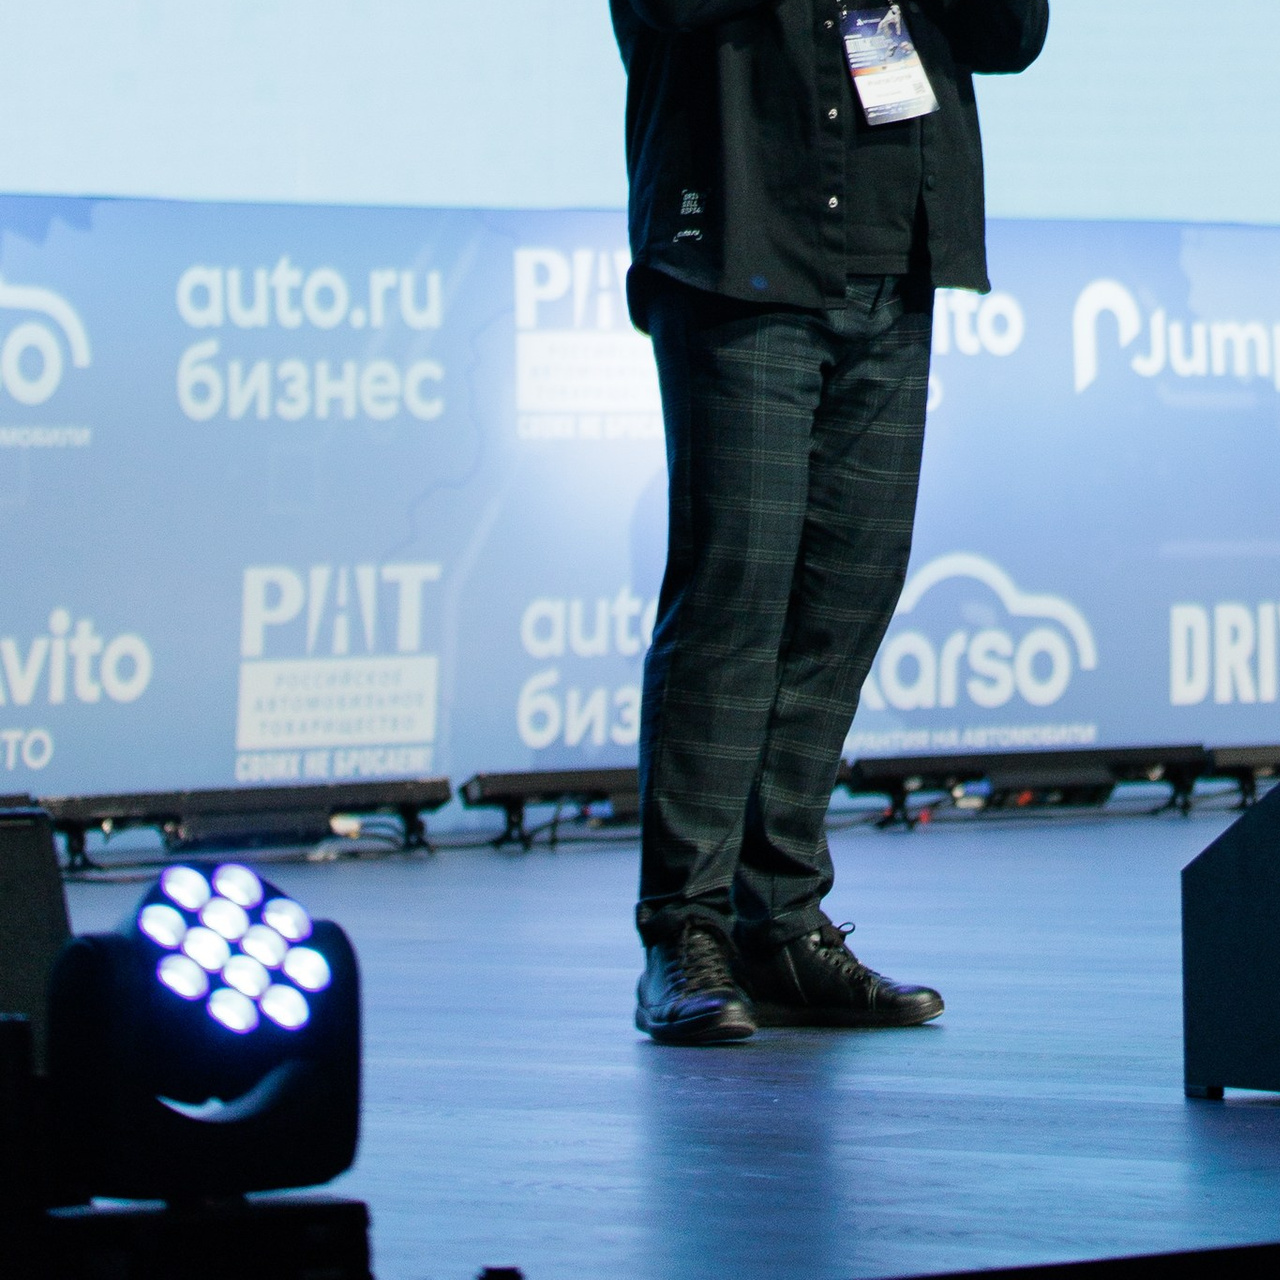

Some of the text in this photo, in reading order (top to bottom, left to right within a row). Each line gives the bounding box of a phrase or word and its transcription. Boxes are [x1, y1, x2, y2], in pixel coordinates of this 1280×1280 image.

[176, 255, 442, 330] auto.ru
[177, 338, 444, 421] бизнес
[0, 607, 153, 707] vito
[861, 627, 1072, 711] arso
